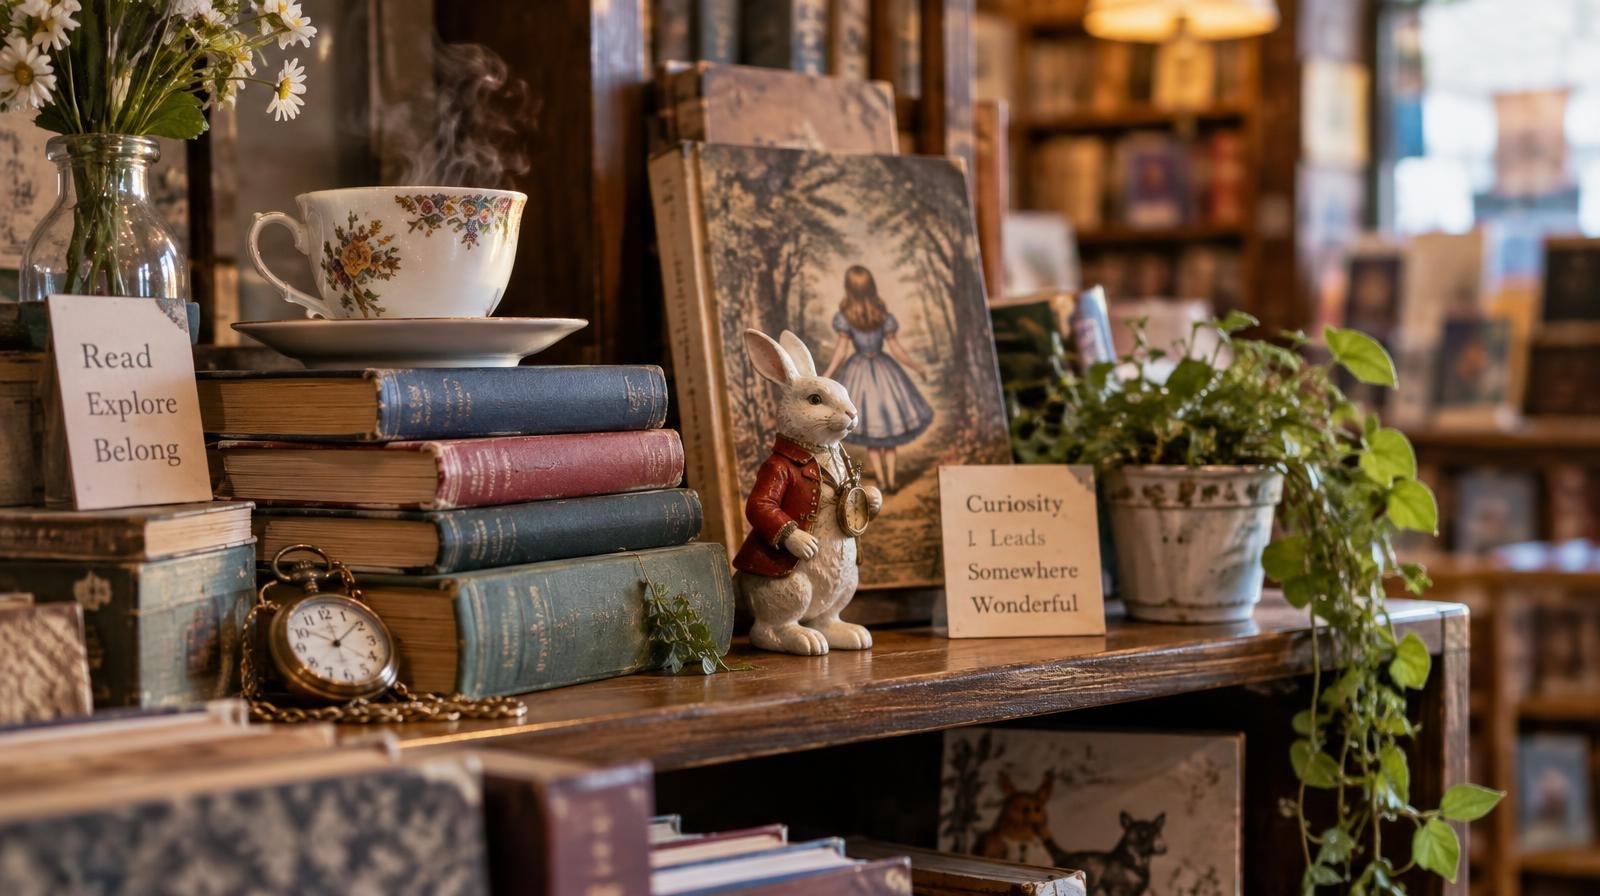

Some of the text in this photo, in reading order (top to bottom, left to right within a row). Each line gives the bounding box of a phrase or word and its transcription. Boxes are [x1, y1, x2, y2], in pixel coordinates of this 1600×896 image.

[81, 343, 153, 369] Read
[86, 390, 178, 422] Explore
[94, 437, 181, 466] Belong
[966, 494, 1063, 517] Curiosity
[990, 528, 1046, 547] Leads
[968, 560, 1078, 581] Somewhere
[971, 594, 1079, 614] Wonderful
[303, 614, 315, 626] 11
[318, 608, 332, 621] 12
[356, 620, 365, 632] 2
[295, 627, 309, 639] 10
[366, 634, 377, 647] 3
[295, 642, 307, 654] 9
[367, 650, 378, 662] 4
[324, 666, 333, 678] 7
[344, 668, 355, 680] 6
[359, 663, 370, 676] 5
